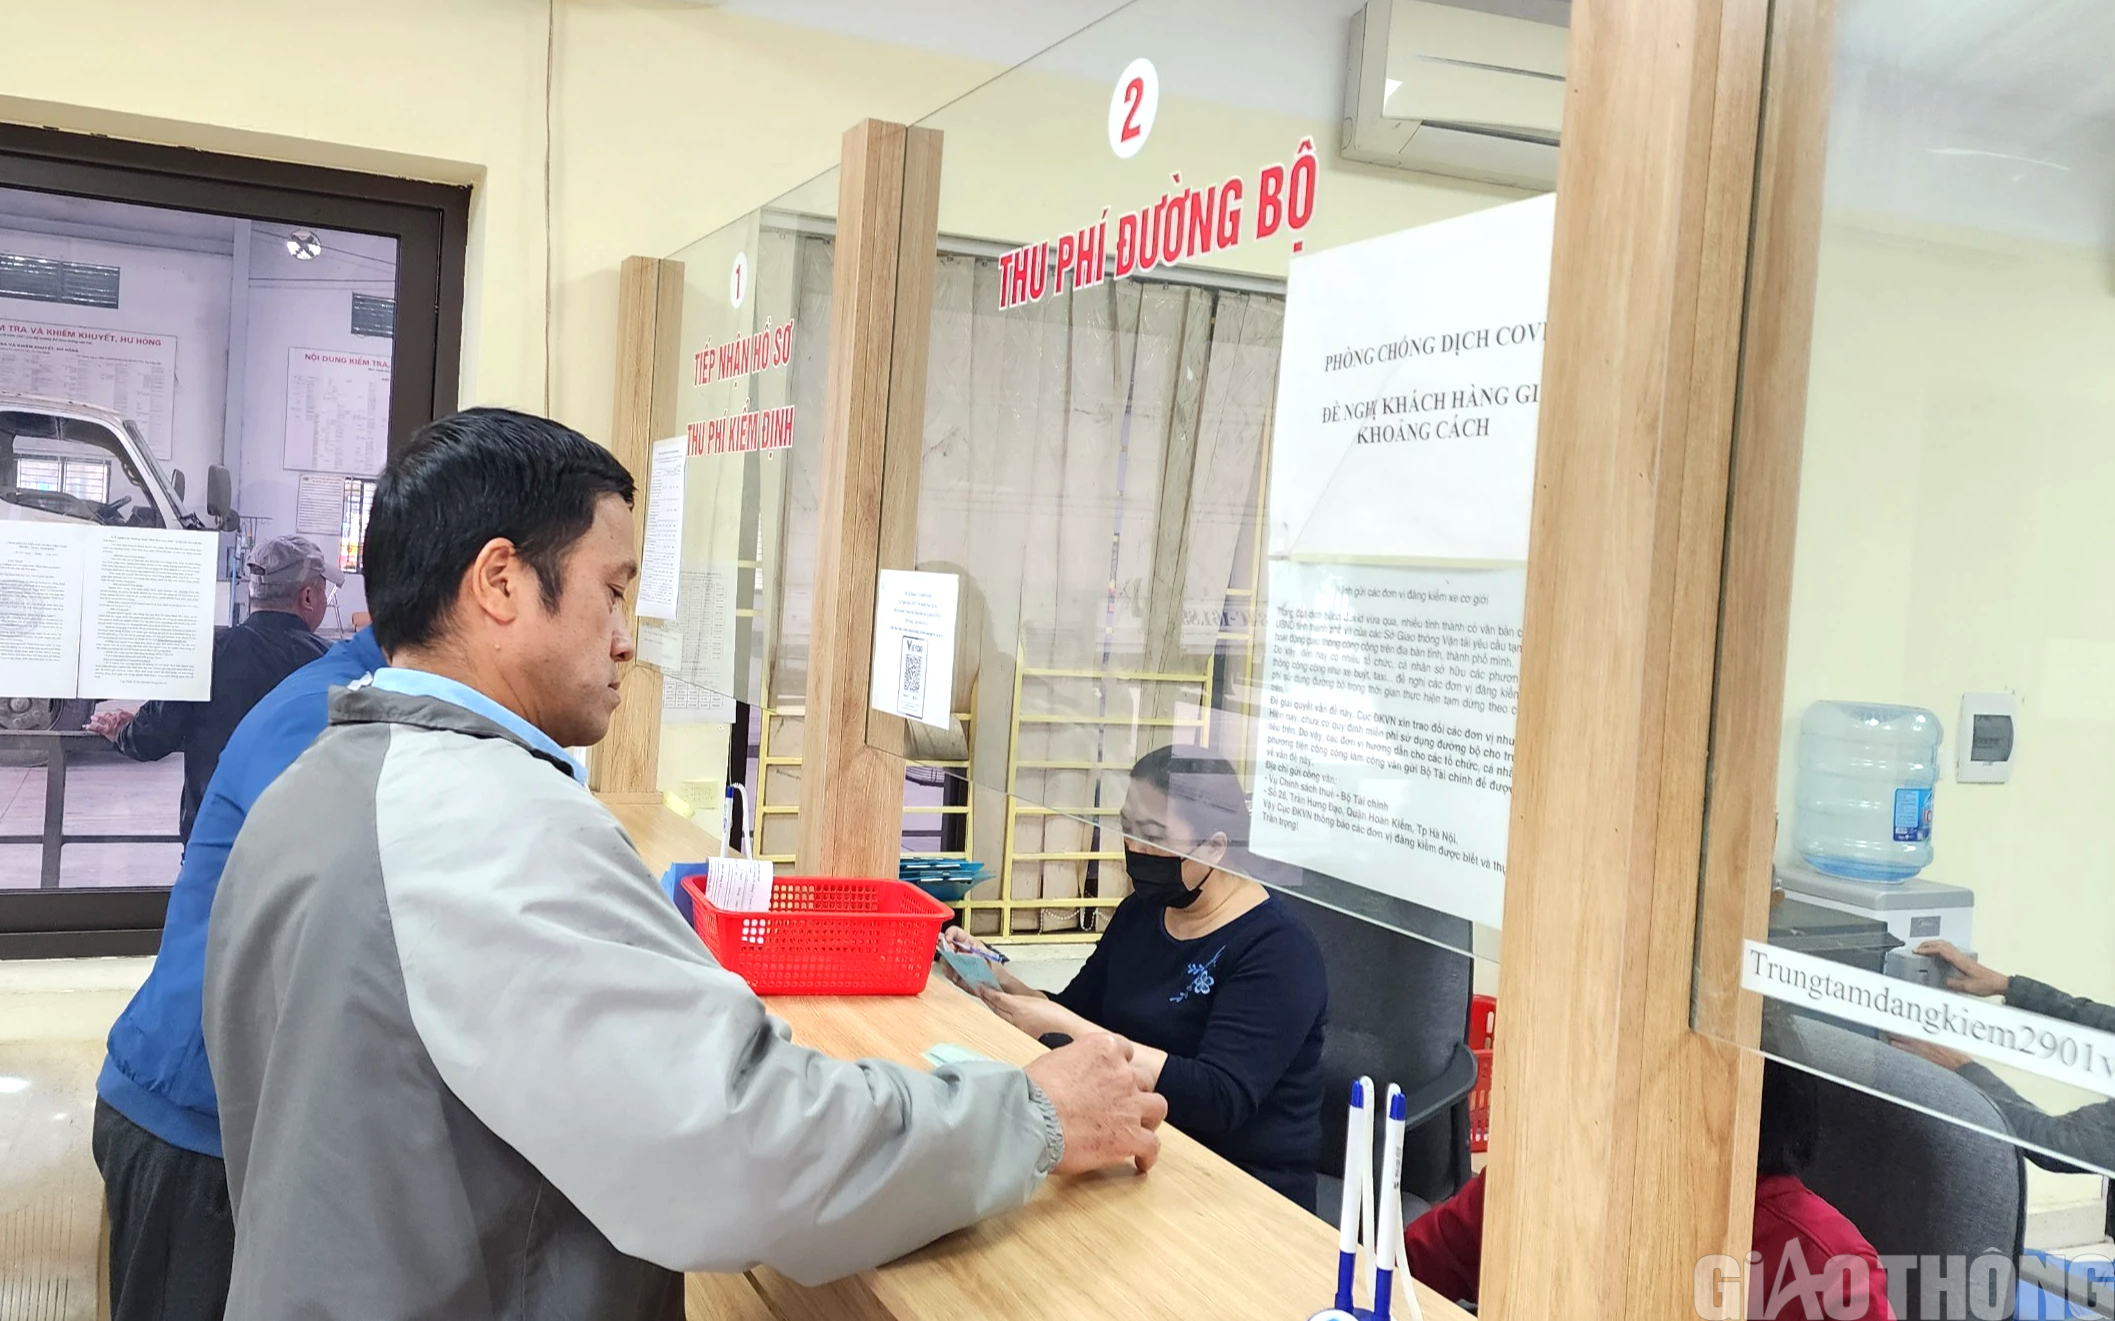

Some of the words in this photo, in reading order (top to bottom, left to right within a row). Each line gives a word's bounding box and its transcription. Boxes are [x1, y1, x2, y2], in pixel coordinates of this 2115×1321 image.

[1120, 77, 1143, 142] 2
[999, 241, 1048, 310] THU
[1055, 206, 1110, 295] PHÍ
[1115, 171, 1244, 280] ĐƯỜNG
[1256, 136, 1318, 254] BỘ
[9, 325, 27, 334] TRA
[305, 353, 320, 363] NỘI
[322, 355, 347, 363] DUNG
[694, 337, 716, 386] TIẾP
[718, 332, 750, 388] NHẬN
[752, 316, 772, 372] HỒ
[773, 319, 794, 368] SƠ
[1324, 346, 1374, 372] PHÒNG
[1378, 335, 1435, 362] CHỐNG
[1441, 328, 1490, 356] DỊCH
[1496, 321, 1548, 347] COVI
[1322, 401, 1340, 424] ĐỀ
[1344, 400, 1377, 421] NGHỊ
[1382, 389, 1446, 416] KHÁCH
[1452, 384, 1509, 409] HÀNG
[1515, 383, 1539, 403] GI
[687, 422, 706, 458] THU
[708, 409, 728, 456] PHÍ
[728, 398, 760, 453] KIỂM
[760, 406, 795, 460] ĐỊNH
[1357, 419, 1431, 445] KHOẢNG
[1435, 414, 1490, 439] CÁCH
[1382, 588, 1397, 598] đơn
[1428, 589, 1447, 601] kiểm
[1460, 594, 1471, 603] cơ
[1397, 631, 1415, 641] Giao
[1428, 678, 1443, 689] các
[1445, 681, 1461, 691] đơn
[1470, 668, 1485, 680] các
[1488, 702, 1508, 714] theo
[1373, 712, 1396, 726] ĐKVN
[1398, 718, 1411, 728] xin
[1413, 720, 1429, 731] trao
[1431, 721, 1445, 733] đổi
[1447, 725, 1462, 737] các
[1464, 728, 1483, 741] đơn
[1486, 732, 1494, 745] vị
[1385, 728, 1399, 741] phí
[1413, 735, 1434, 749] dụng
[1437, 738, 1466, 755] đường
[1469, 744, 1480, 758] bộ
[1483, 748, 1501, 759] cho
[1410, 749, 1426, 761] cho
[1428, 752, 1442, 763] các
[1420, 765, 1431, 779] Bộ
[1434, 767, 1446, 780] Tài
[1448, 771, 1473, 785] chính
[1341, 790, 1351, 803] Bộ
[1307, 797, 1327, 812] Hưng
[1417, 823, 1427, 836] Tp
[1429, 827, 1440, 839] Hà
[1292, 806, 1312, 820] ĐKVN
[1351, 823, 1365, 835] các
[1367, 826, 1383, 839] đơn
[1386, 832, 1393, 844] vị
[1394, 833, 1415, 849] đăng
[1417, 836, 1436, 853] kiểm
[1438, 845, 1461, 861] được
[1463, 851, 1478, 867] biết
[1480, 858, 1491, 869] và
